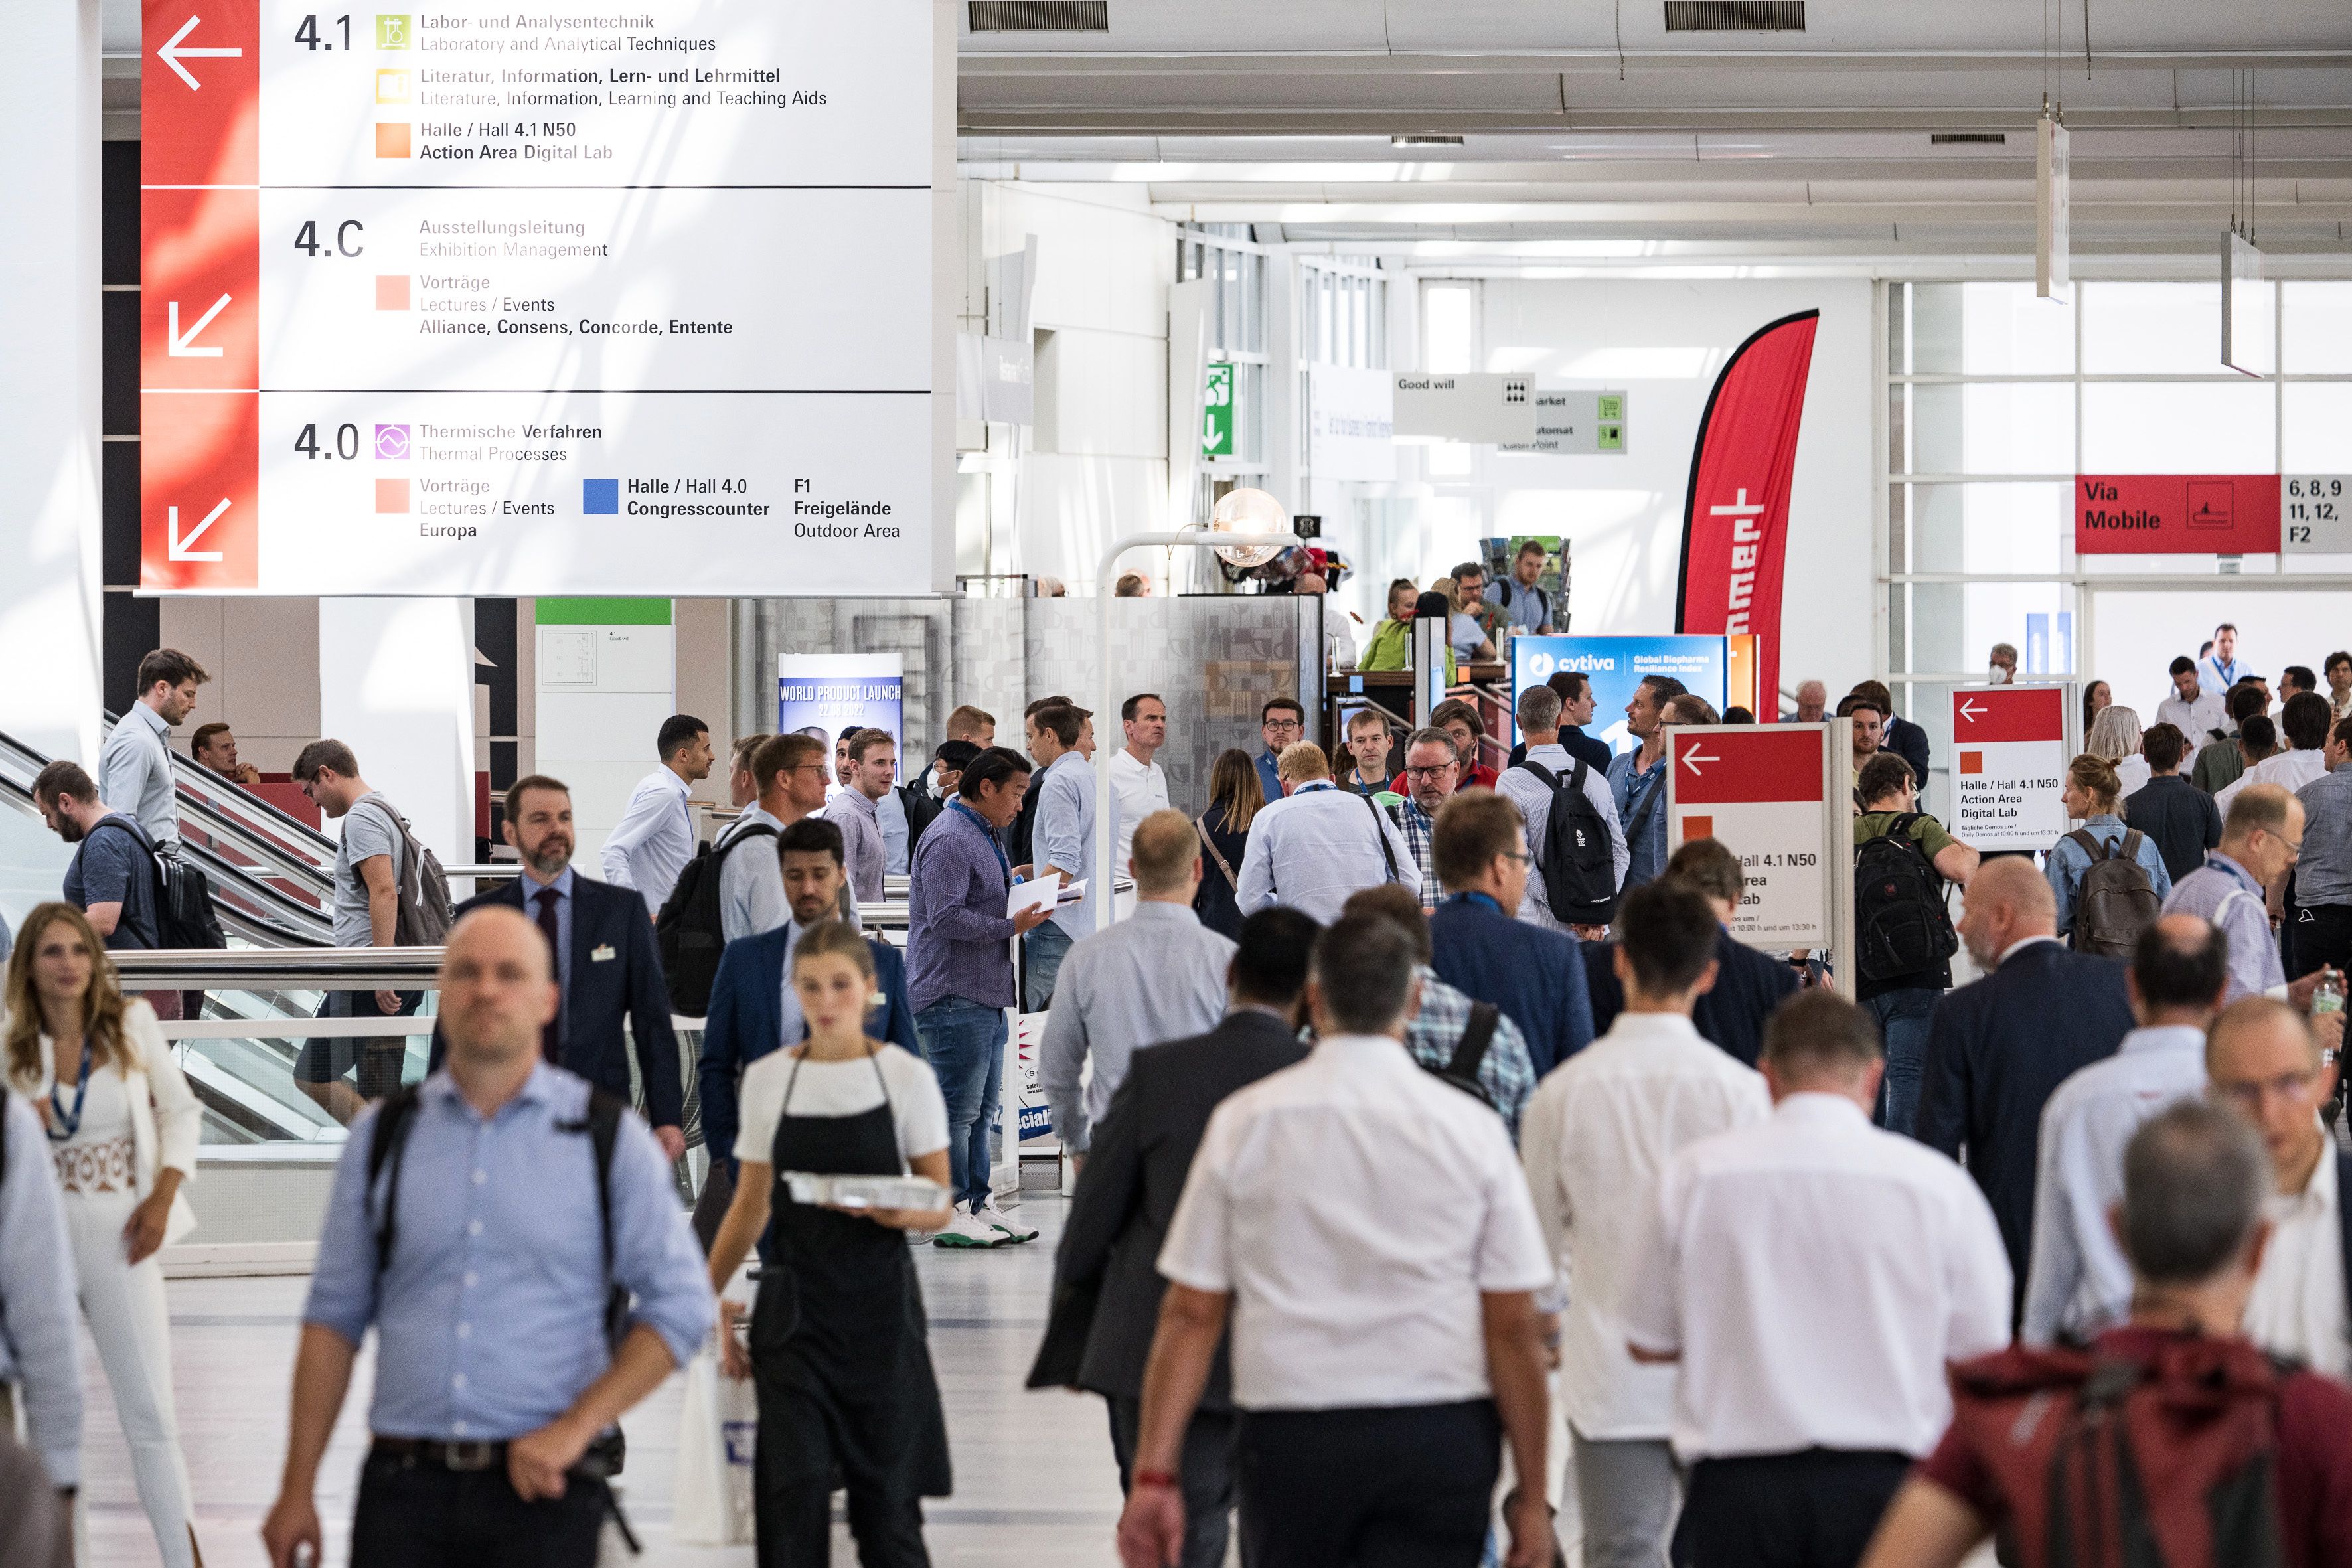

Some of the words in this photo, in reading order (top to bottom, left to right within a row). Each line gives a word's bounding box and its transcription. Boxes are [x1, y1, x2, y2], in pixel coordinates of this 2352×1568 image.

[420, 13, 473, 29] Labor-
[479, 14, 510, 29] und
[515, 14, 655, 33] Analysentechnik
[294, 14, 351, 52] 4.1
[420, 36, 505, 54] Laboratory
[510, 37, 538, 51] and
[544, 36, 622, 54] Analytical
[626, 36, 716, 54] Techniques
[420, 68, 495, 86] Literatur,
[501, 68, 603, 86] Information,
[609, 68, 653, 84] Lern-
[657, 68, 689, 84] und
[694, 68, 781, 84] Lehrmittel
[420, 90, 501, 108] Literature,
[507, 90, 603, 108] Information,
[608, 90, 677, 109] Learning
[681, 90, 711, 107] and
[716, 90, 787, 110] Teaching
[791, 90, 828, 106] Aids
[420, 122, 463, 137] Halle
[466, 122, 474, 137] /
[479, 122, 509, 137] Hall
[514, 122, 537, 137] 4.1
[542, 122, 577, 137] N50
[420, 144, 474, 160] Action
[478, 144, 518, 160] Area
[524, 144, 578, 163] Digital
[584, 144, 614, 160] Lab
[420, 219, 586, 238] Ausstellungsleitung
[294, 219, 364, 258] 4.C
[420, 242, 497, 257] Exhibition
[503, 242, 610, 260] Management
[420, 274, 491, 293] Vorträge
[420, 297, 487, 312] Lectures
[491, 297, 497, 312] /
[503, 297, 556, 312] Events
[420, 319, 491, 337] Alliance,
[497, 319, 574, 337] Consens,
[579, 319, 664, 337] Concorde,
[668, 319, 734, 335] Entente
[1398, 378, 1430, 390] Good
[1433, 378, 1455, 390] will
[1536, 396, 1566, 407] arket
[419, 424, 516, 439] Thermische
[522, 424, 602, 439] Verfahren
[1536, 426, 1573, 435] utomat
[294, 422, 359, 461] 4.0
[420, 446, 483, 461] Thermal
[489, 446, 567, 461] Processes
[420, 478, 491, 497] Vorträge
[627, 478, 670, 494] Halle
[674, 478, 681, 494] /
[686, 478, 716, 494] Hall
[721, 478, 747, 494] 4.0
[794, 478, 811, 494] F1
[2084, 481, 2118, 501] Via
[2289, 479, 2306, 499] 6,
[2310, 479, 2326, 499] 8,
[2331, 479, 2342, 497] 9
[420, 500, 487, 516] Lectures
[491, 500, 498, 516] /
[503, 501, 556, 516] Events
[627, 501, 770, 520] Congresscounter
[794, 500, 892, 520] Freigelände
[2289, 503, 2310, 522] 11,
[2315, 503, 2339, 522] 12,
[2084, 509, 2161, 530] Mobile
[420, 522, 477, 541] Europa
[794, 522, 859, 538] Outdoor
[863, 522, 900, 538] Area
[2290, 526, 2311, 543] F2
[1559, 654, 1615, 672] cytiva
[1634, 655, 1662, 664] Global
[1663, 655, 1709, 665] Biopharma
[780, 686, 814, 701] WORLD
[817, 685, 861, 701] PRODUCT
[864, 684, 902, 700] LAUNCH
[1960, 780, 1988, 790] Halle
[1990, 780, 1994, 790] /
[1998, 779, 2017, 789] Hall
[2019, 779, 2034, 789] 4.1
[2037, 779, 2059, 789] N50
[1960, 795, 1995, 804] Action
[1998, 794, 2023, 803] Area
[1961, 808, 1996, 820] Digital
[1999, 807, 2017, 817] Lab
[1763, 854, 1783, 867] 4.1
[1787, 853, 1817, 866] N50
[1744, 876, 1767, 886] rea
